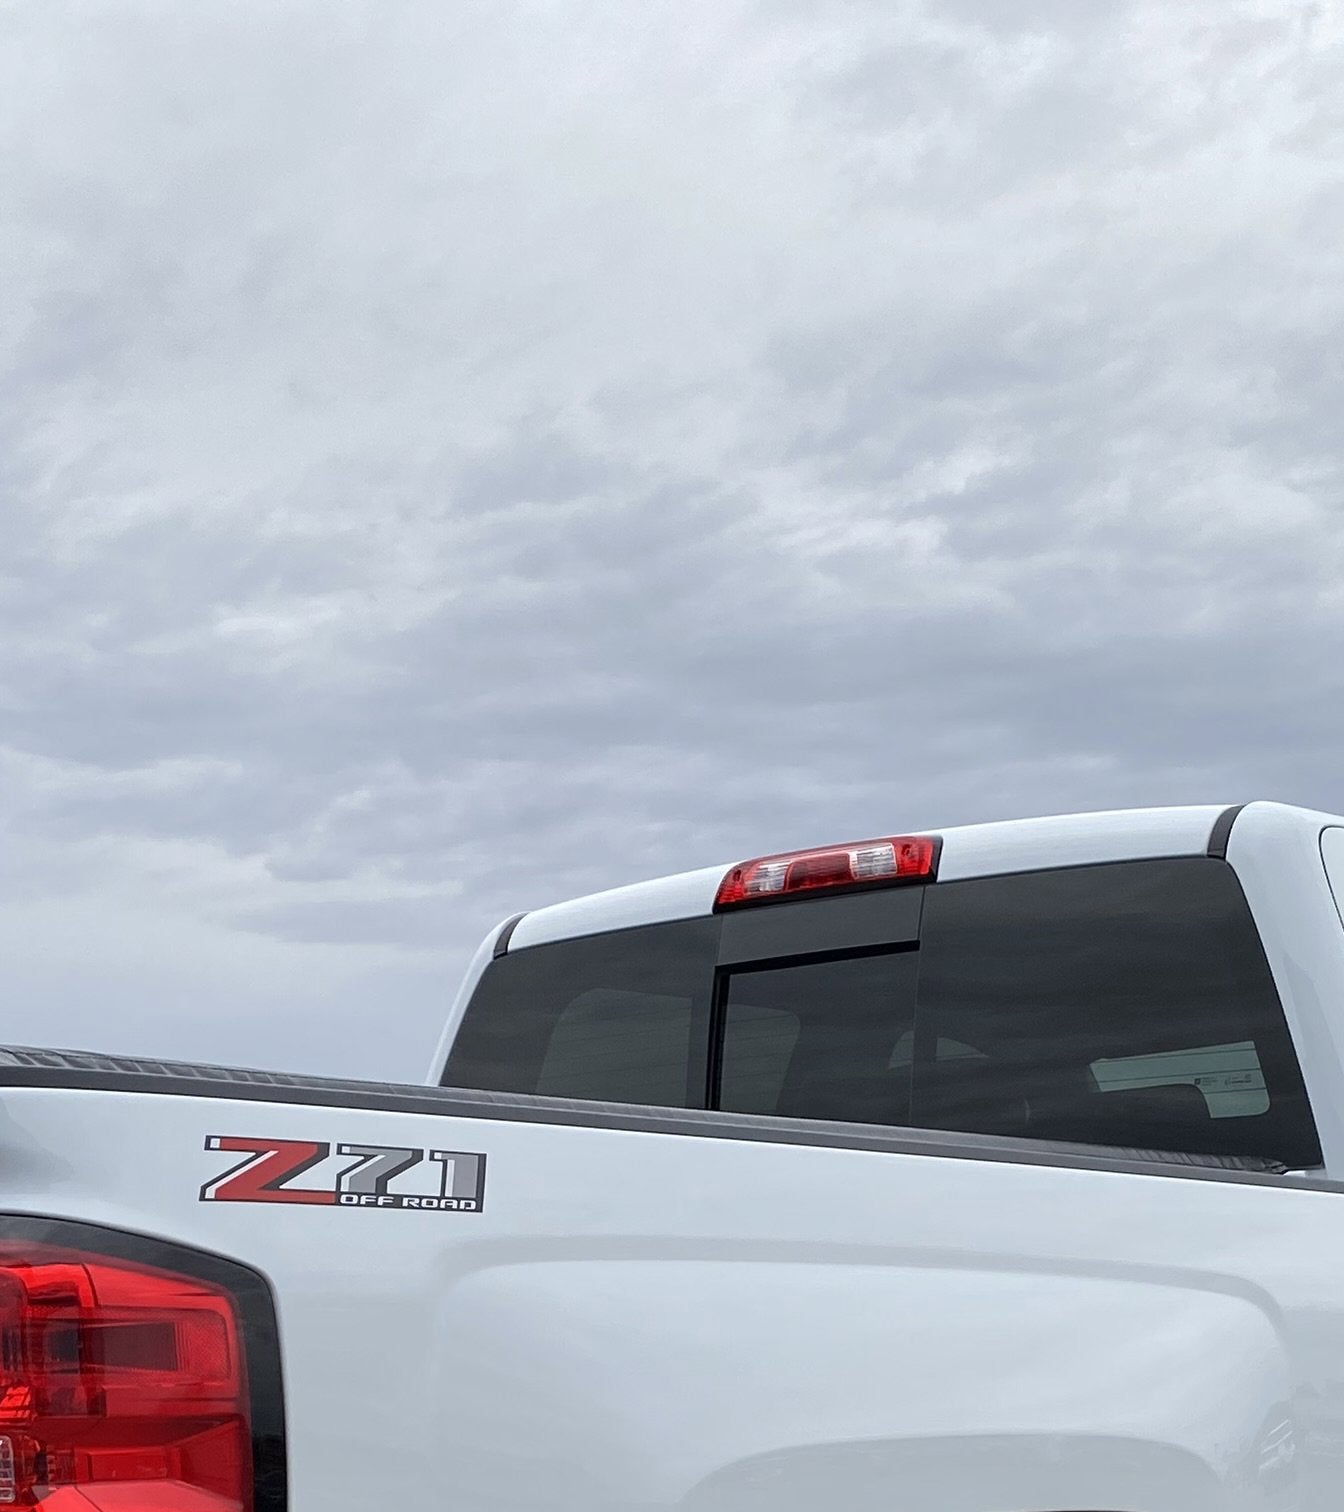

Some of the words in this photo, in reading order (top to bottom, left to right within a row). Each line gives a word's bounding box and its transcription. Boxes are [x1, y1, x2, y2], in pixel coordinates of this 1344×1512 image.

[199, 1135, 487, 1209] Z71
[340, 1193, 394, 1207] OFF
[402, 1196, 477, 1211] ROAD
